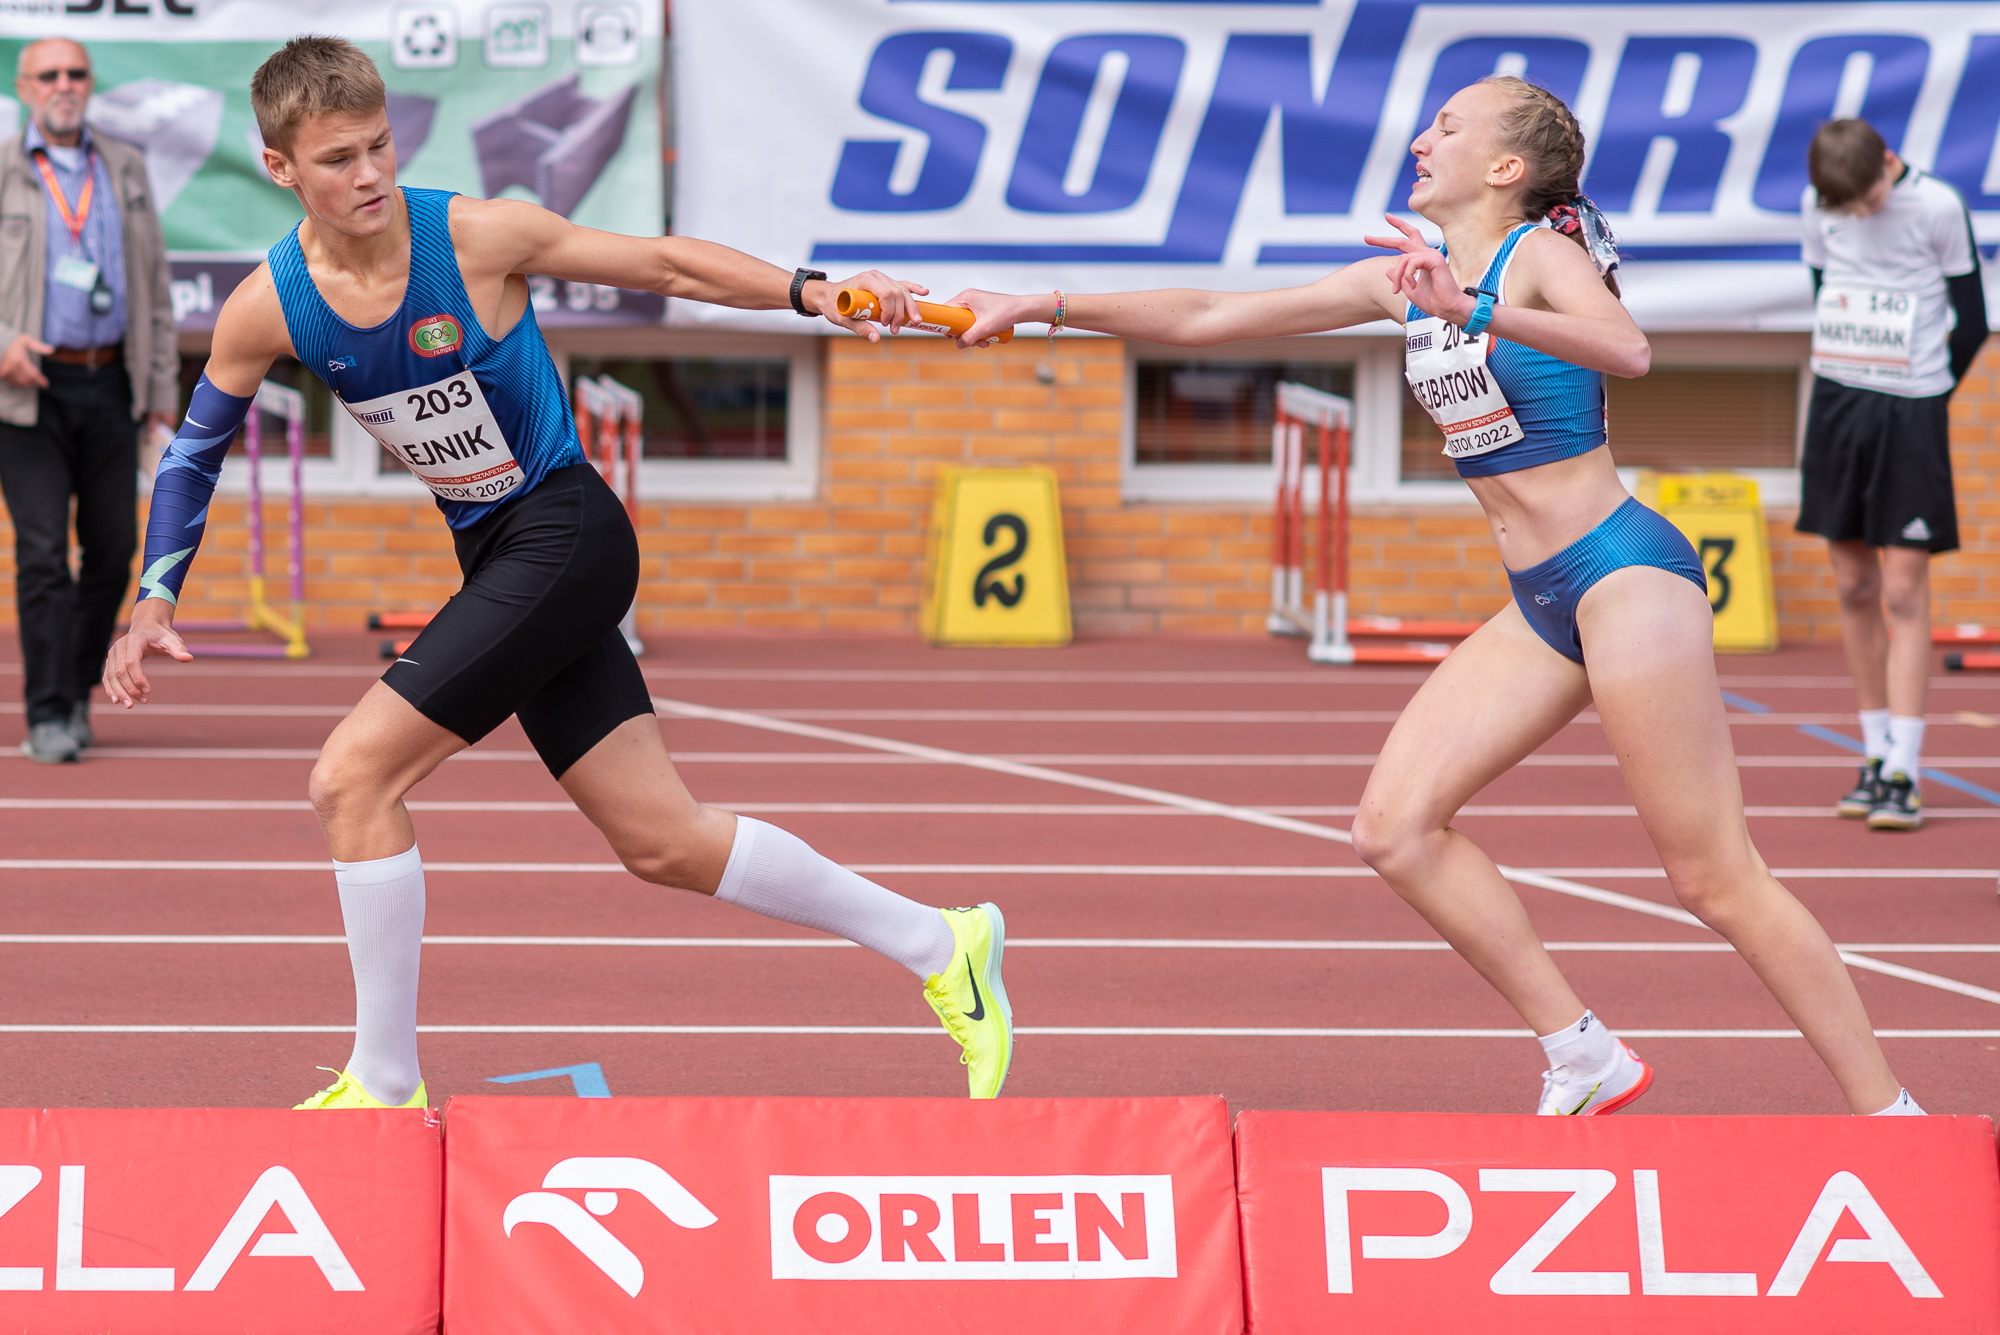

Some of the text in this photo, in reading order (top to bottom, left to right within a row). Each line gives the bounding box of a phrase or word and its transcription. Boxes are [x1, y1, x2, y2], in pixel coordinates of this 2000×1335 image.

[1868, 293, 1909, 315] 140
[1819, 322, 1906, 348] MATUSIAK
[407, 380, 473, 422] 203
[390, 424, 495, 466] LEJNIK
[1474, 424, 1513, 448] 2022
[472, 462, 514, 481] SZTAFETACH
[476, 475, 518, 498] 2022
[973, 513, 1029, 608] 2
[793, 1191, 1149, 1263] ORLEN
[1321, 1167, 1945, 1298] PZLA
